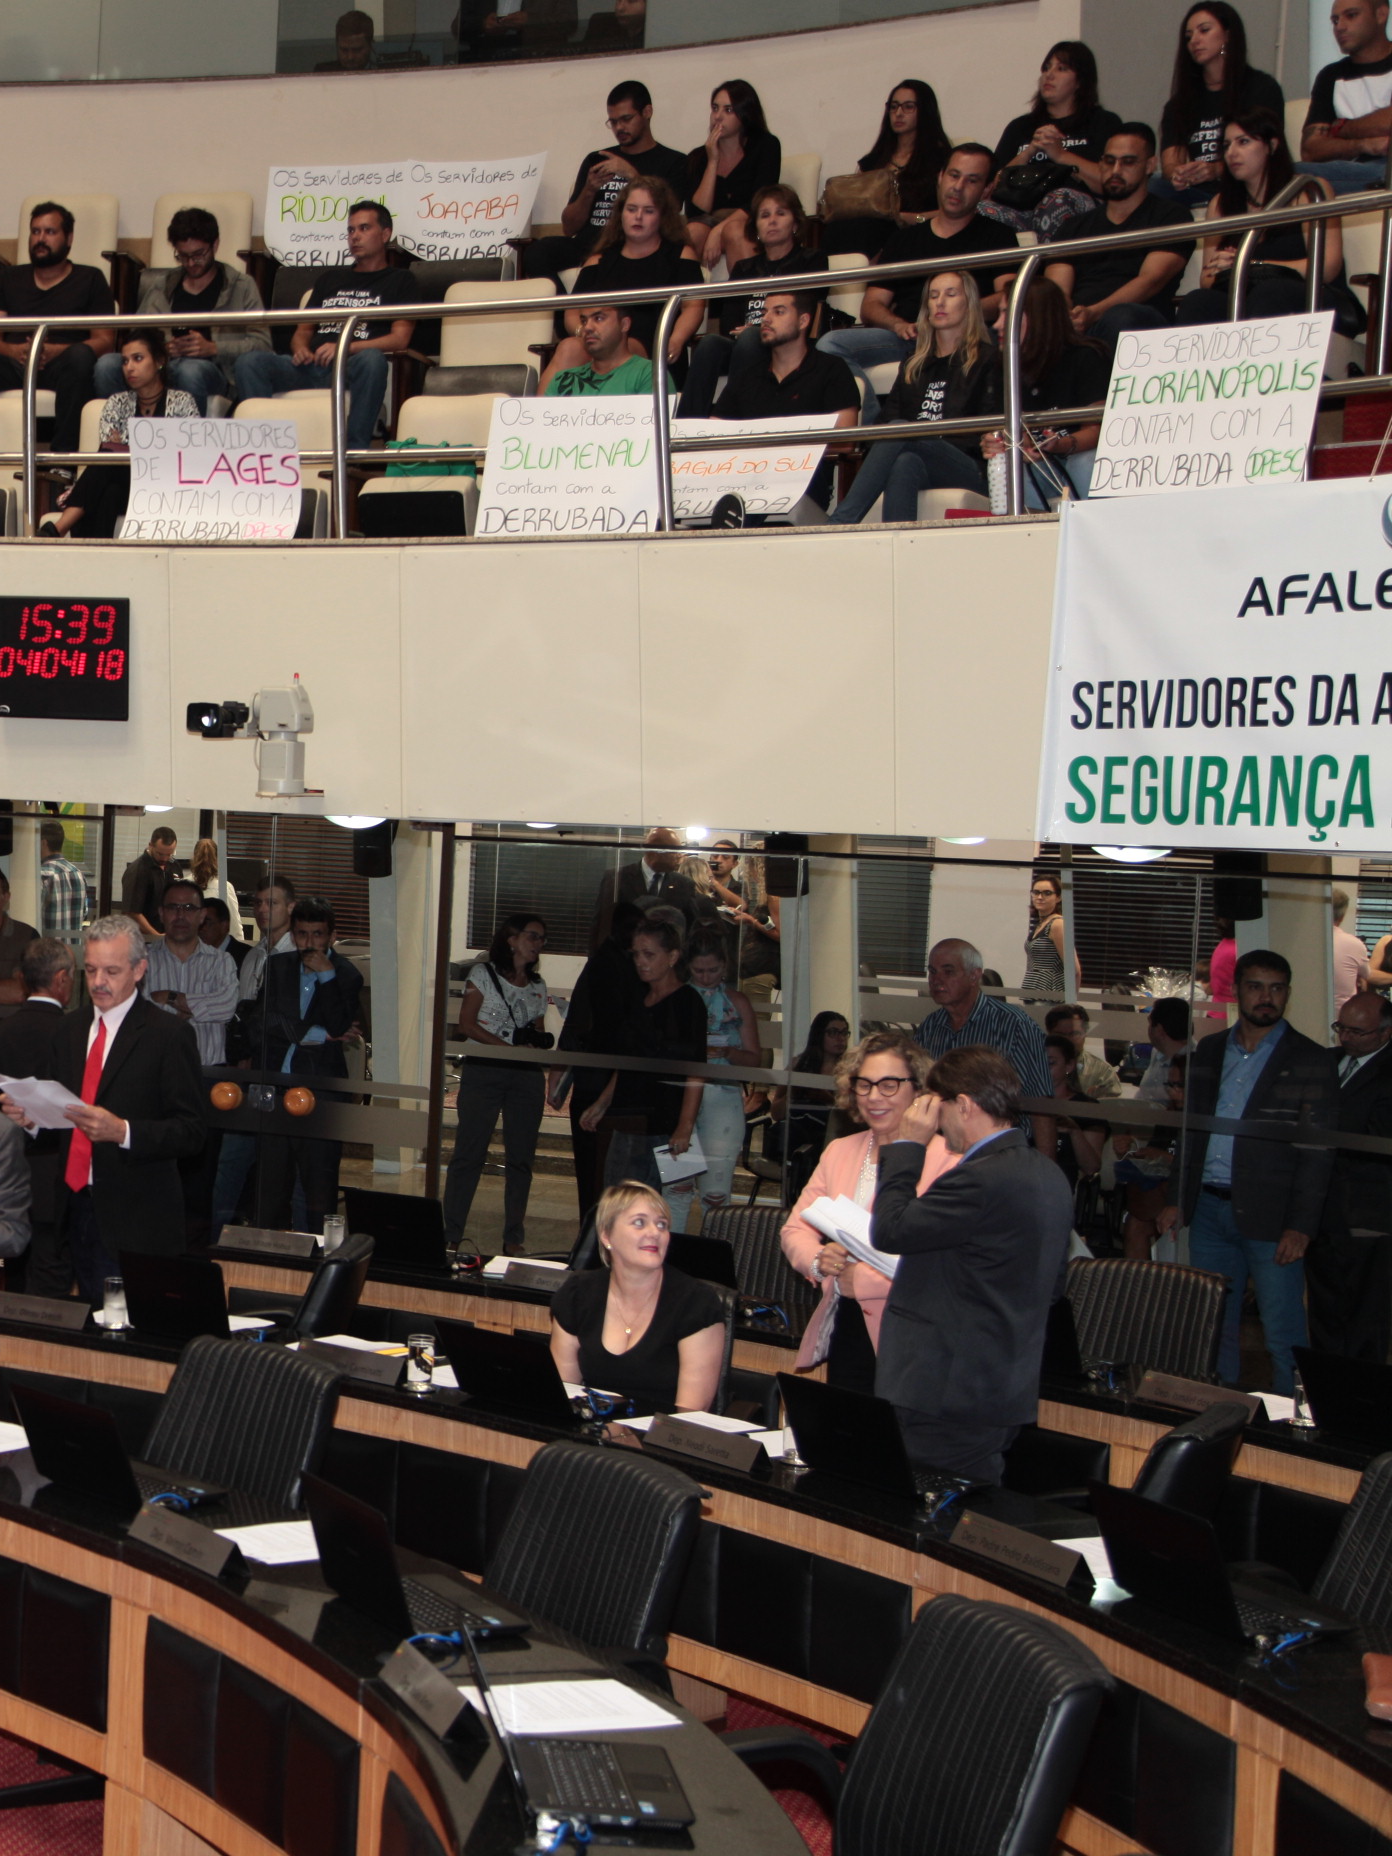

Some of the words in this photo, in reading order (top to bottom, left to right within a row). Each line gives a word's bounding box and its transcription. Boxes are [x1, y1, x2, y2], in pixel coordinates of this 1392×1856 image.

[386, 170, 404, 182] de
[521, 165, 538, 179] de
[416, 192, 520, 224] JOAÇABA
[338, 233, 349, 241] co
[500, 228, 513, 236] a
[1158, 323, 1281, 363] SERVIDORES
[1287, 321, 1322, 351] DE
[1110, 358, 1319, 410] FLORIANÓPOLIS
[500, 399, 534, 426] Os
[641, 409, 655, 425] d
[1106, 412, 1194, 447] CONTAM
[1210, 407, 1262, 440] COM
[1273, 404, 1294, 438] A
[176, 420, 296, 450] SERVIDORES
[500, 436, 650, 470] BLUMENAU
[736, 460, 768, 474] DO
[774, 452, 815, 472] SUL
[132, 456, 160, 481] DE
[178, 451, 300, 487] LAGES
[1088, 452, 1233, 492] DERRUBADA
[132, 488, 221, 516] CONTAM
[231, 490, 275, 517] COM
[280, 493, 294, 518] A
[602, 484, 616, 495] a
[120, 519, 240, 540] DERRUBADA
[478, 506, 648, 534] DERRUBADA
[19, 603, 117, 646] 15:39
[1070, 674, 1297, 731] SERVIDORES
[1307, 673, 1360, 727] DA
[1064, 753, 1375, 843] SEGURANÇA
